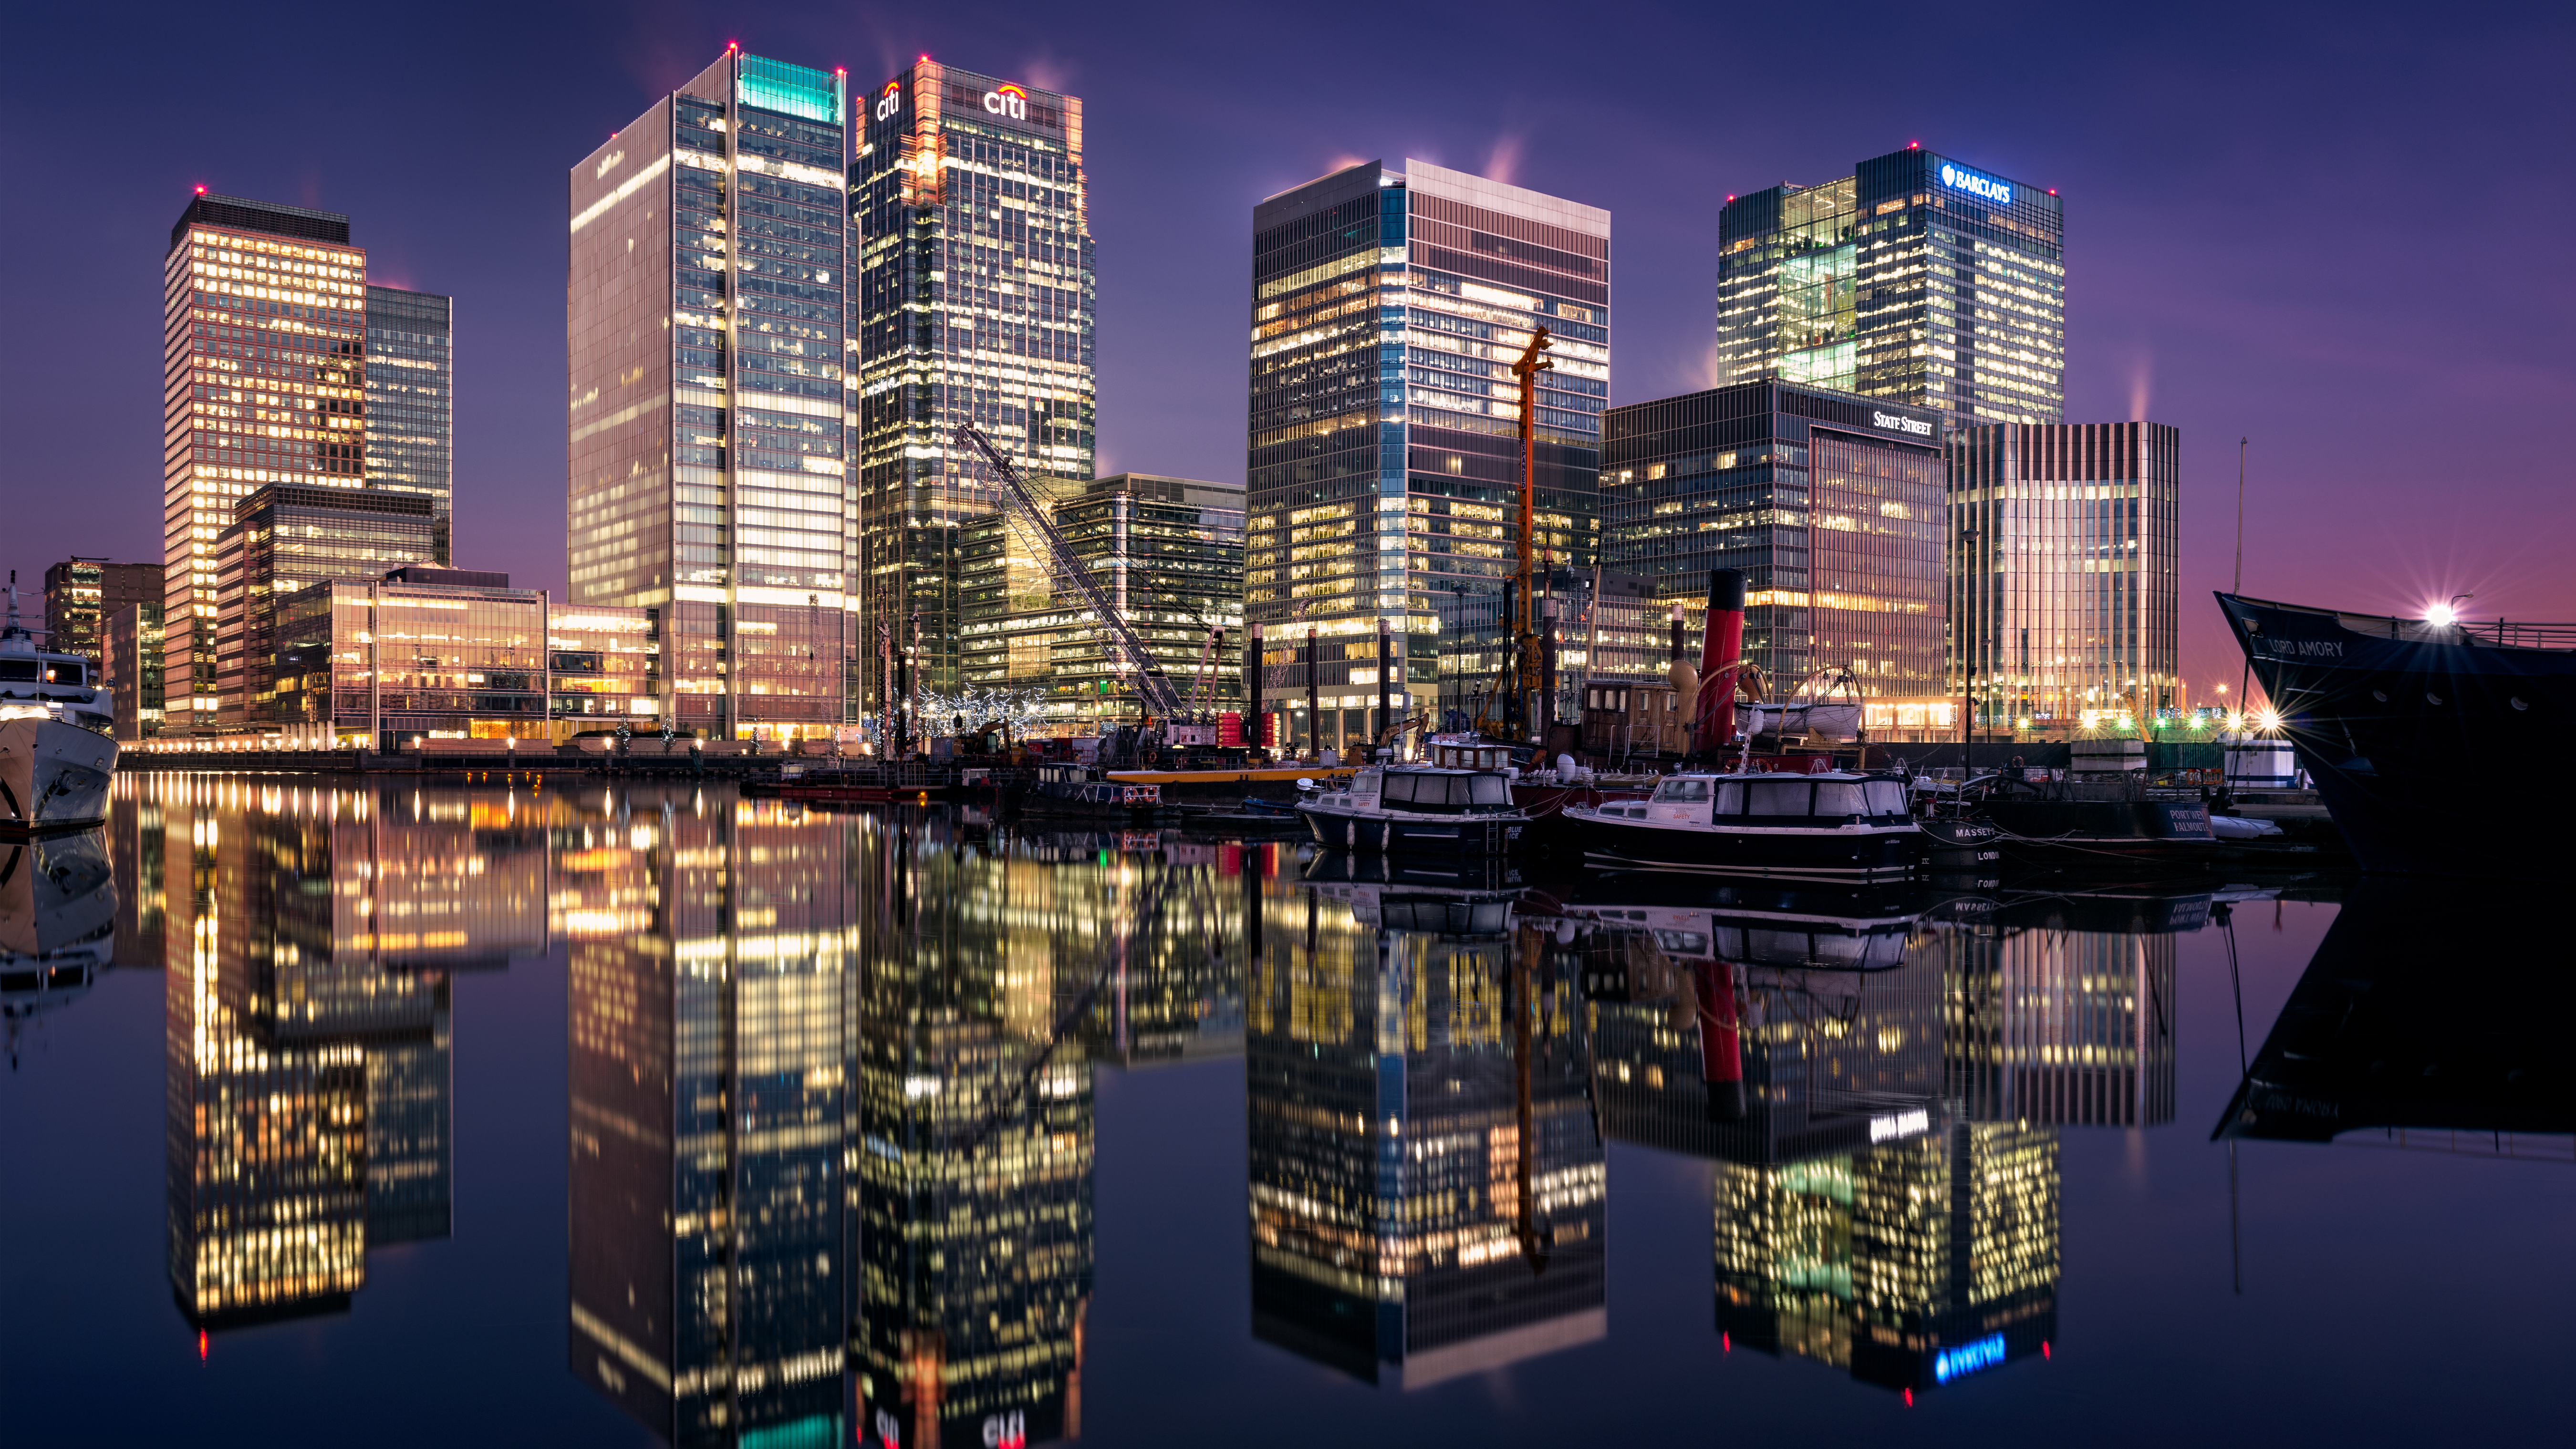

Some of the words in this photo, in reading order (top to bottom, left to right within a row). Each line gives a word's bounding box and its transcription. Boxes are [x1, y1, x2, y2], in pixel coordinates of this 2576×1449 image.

[877, 88, 899, 122] citi
[984, 92, 1025, 120] citi
[1956, 171, 2010, 203] BARCLAYS
[1874, 411, 1900, 429] STATE
[1901, 416, 1932, 435] STREET
[2268, 639, 2296, 654] LORD
[2298, 641, 2342, 656] AMORY
